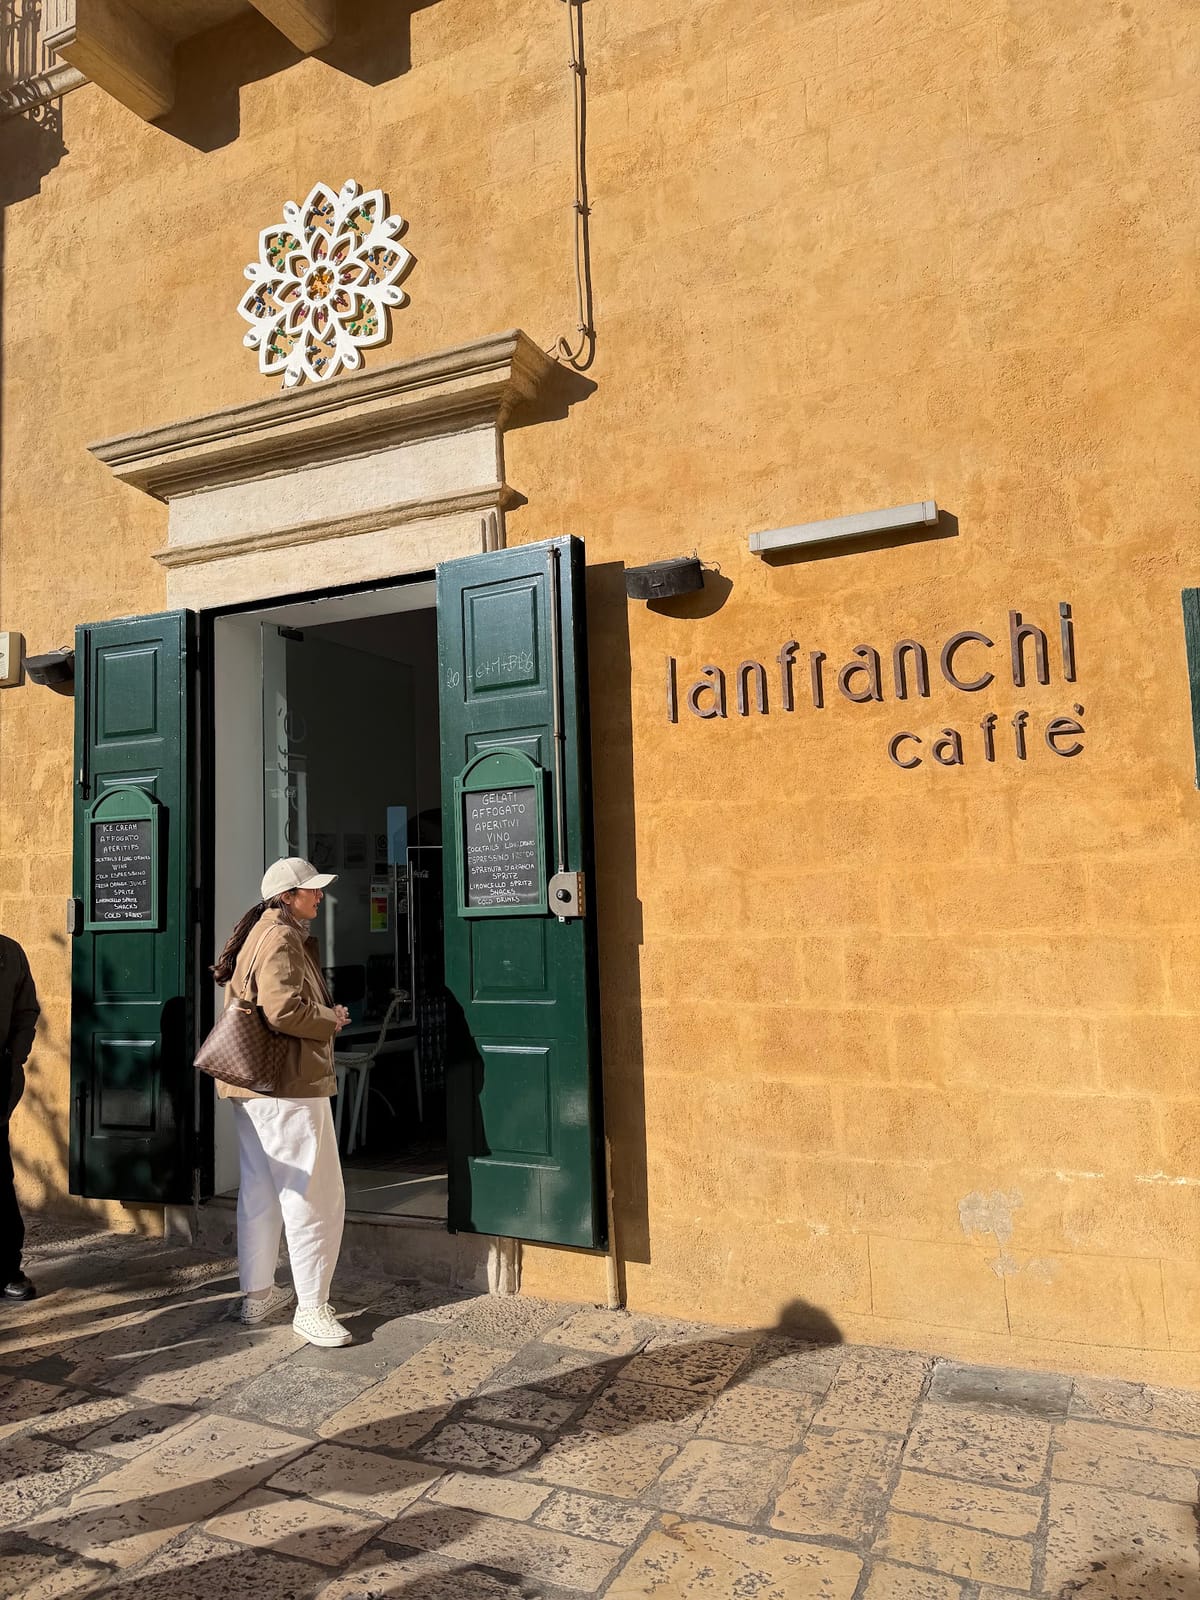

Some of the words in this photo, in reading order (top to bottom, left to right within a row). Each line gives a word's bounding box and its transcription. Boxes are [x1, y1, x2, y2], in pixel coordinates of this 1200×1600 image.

[665, 601, 1077, 723] lanfranchi
[888, 703, 1085, 768] caffè
[482, 791, 517, 805] GELATI
[472, 804, 526, 820] AFFOGATO
[102, 824, 113, 833] ICE
[115, 823, 138, 832] CREAM
[475, 818, 519, 832] APERITIVI
[100, 834, 140, 842] AFFOGATO
[486, 832, 510, 843] VINO
[103, 844, 140, 854] APERITIFS
[467, 844, 499, 854] COCKTAILS
[112, 863, 127, 871] WINE
[471, 866, 502, 875] SPREMUTA
[492, 872, 518, 880] SPRITZ
[129, 879, 147, 887] JUICE
[469, 882, 506, 890] LIMONCELLO
[490, 888, 516, 896] SNACKS
